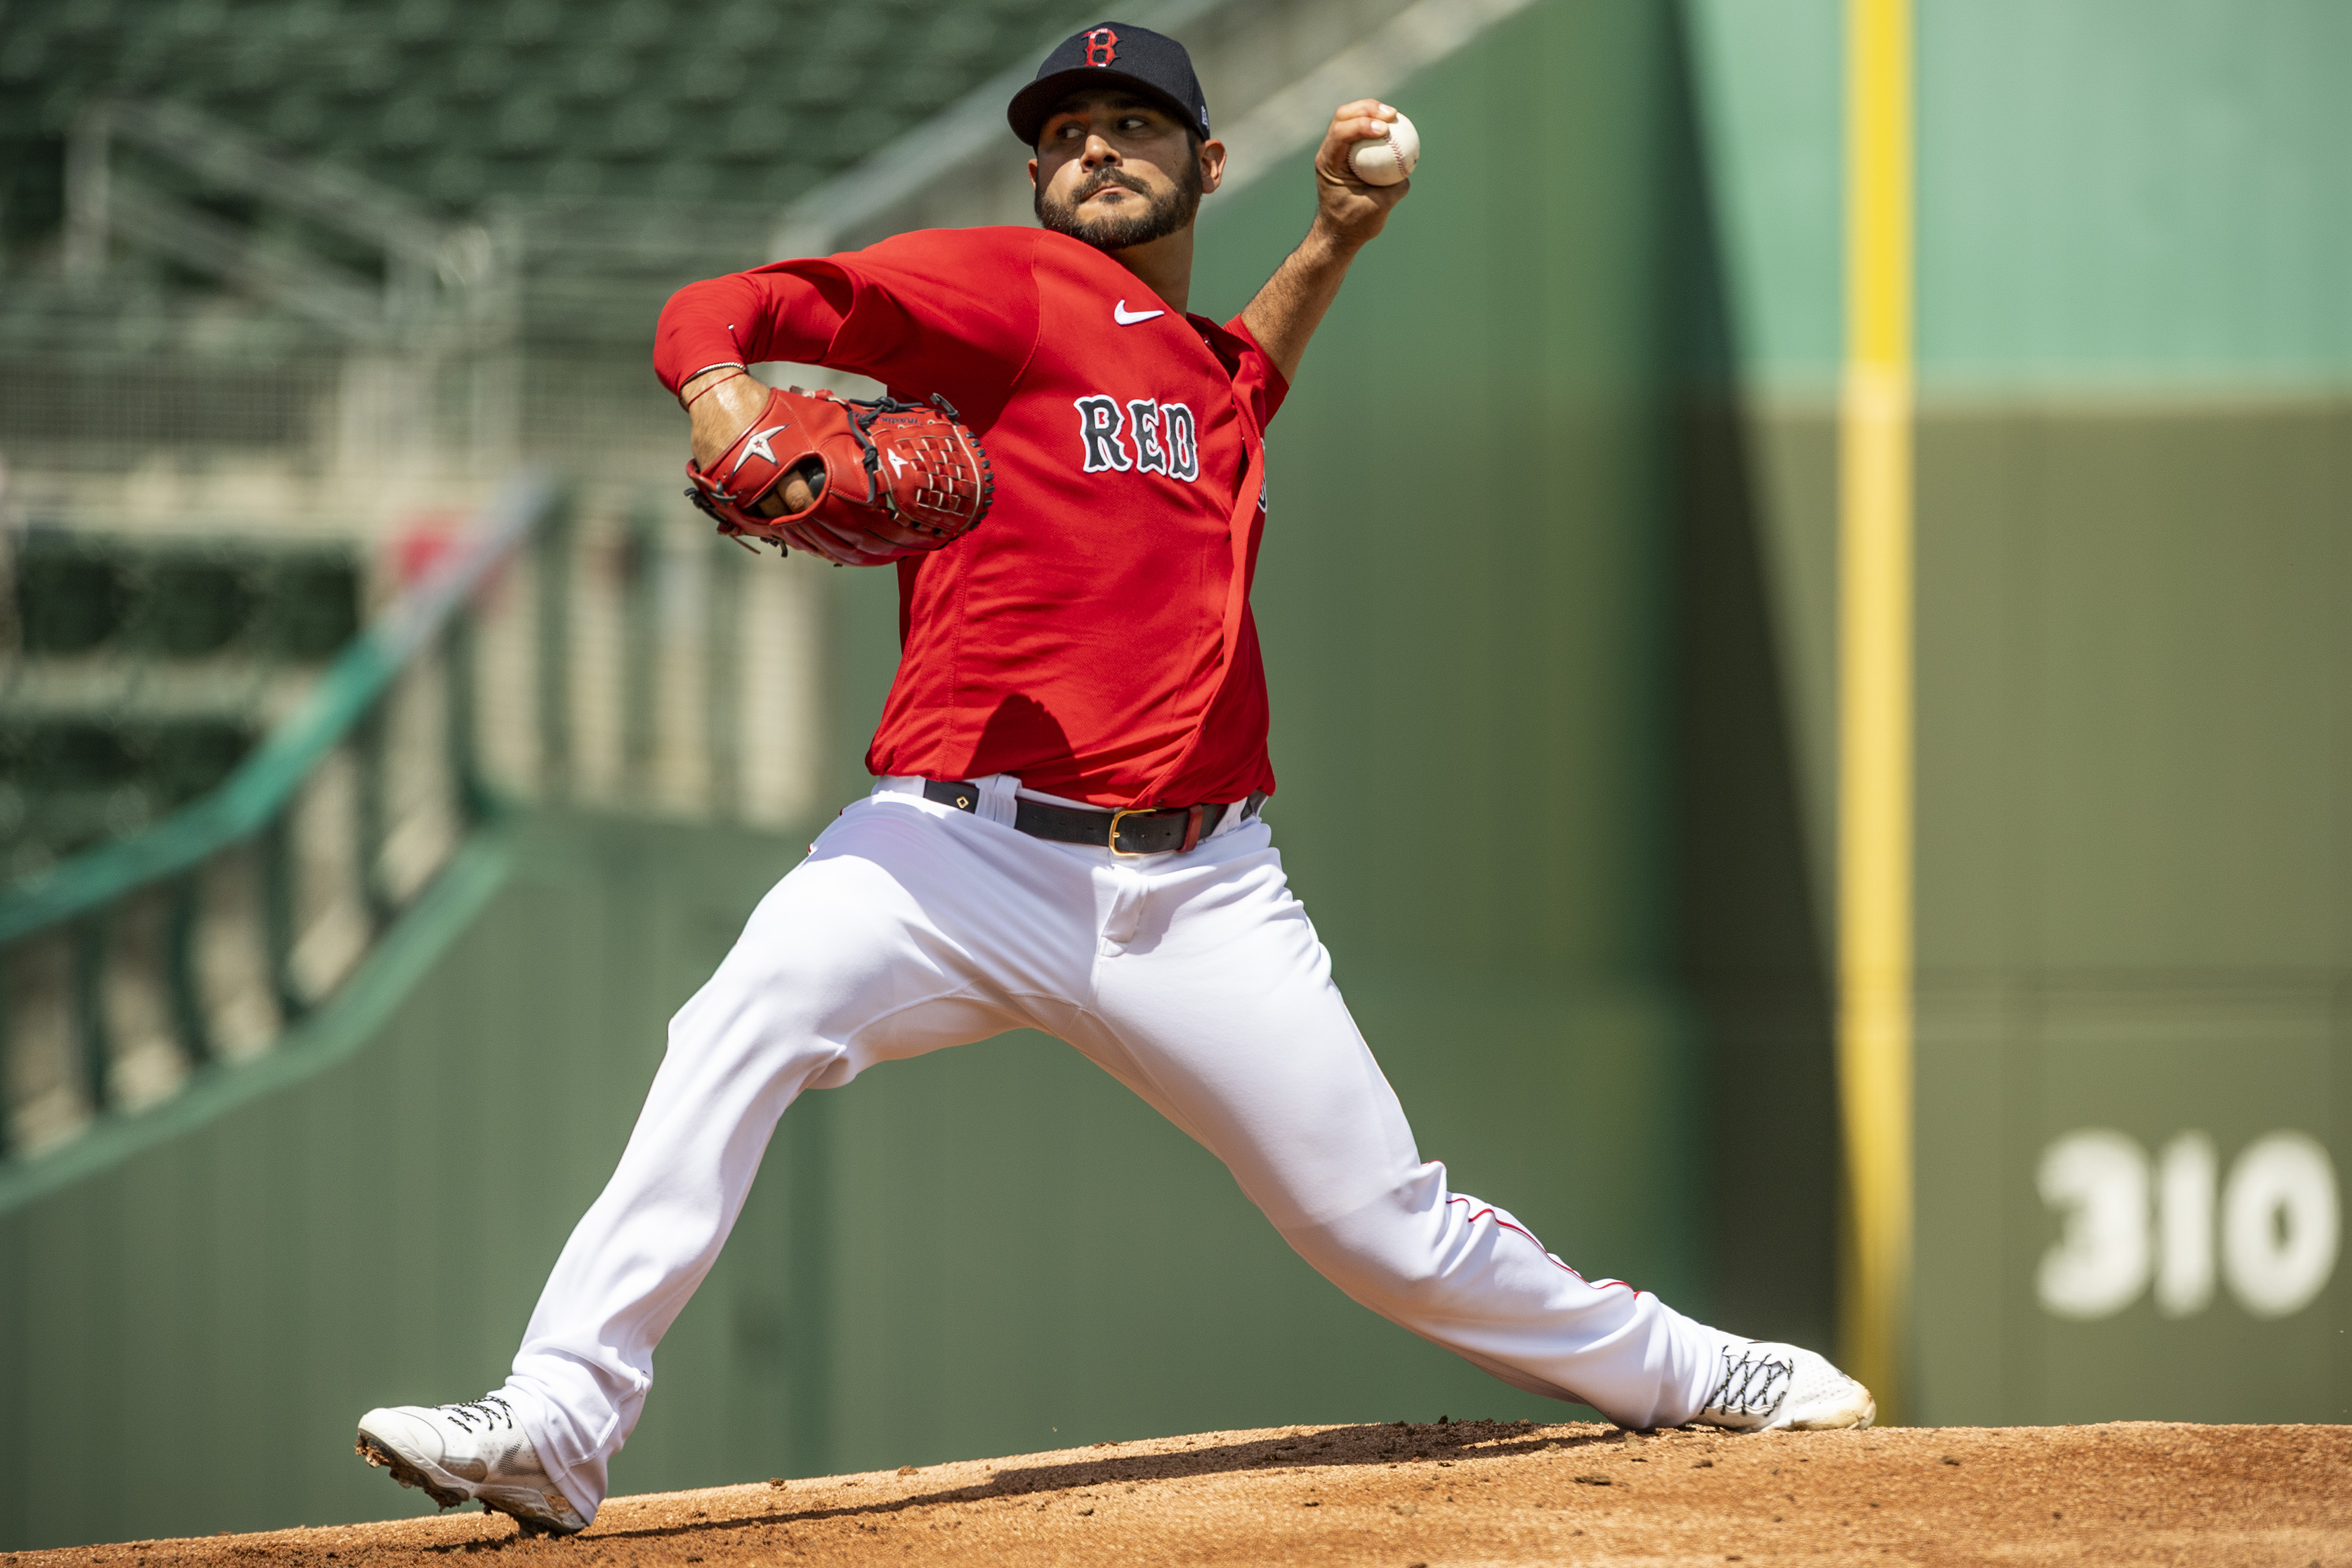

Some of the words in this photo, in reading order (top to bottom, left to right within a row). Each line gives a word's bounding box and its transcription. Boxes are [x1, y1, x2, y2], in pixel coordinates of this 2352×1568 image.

[1082, 28, 1118, 67] B
[1073, 394, 1199, 482] RED
[2034, 1130, 2341, 1320] 310
